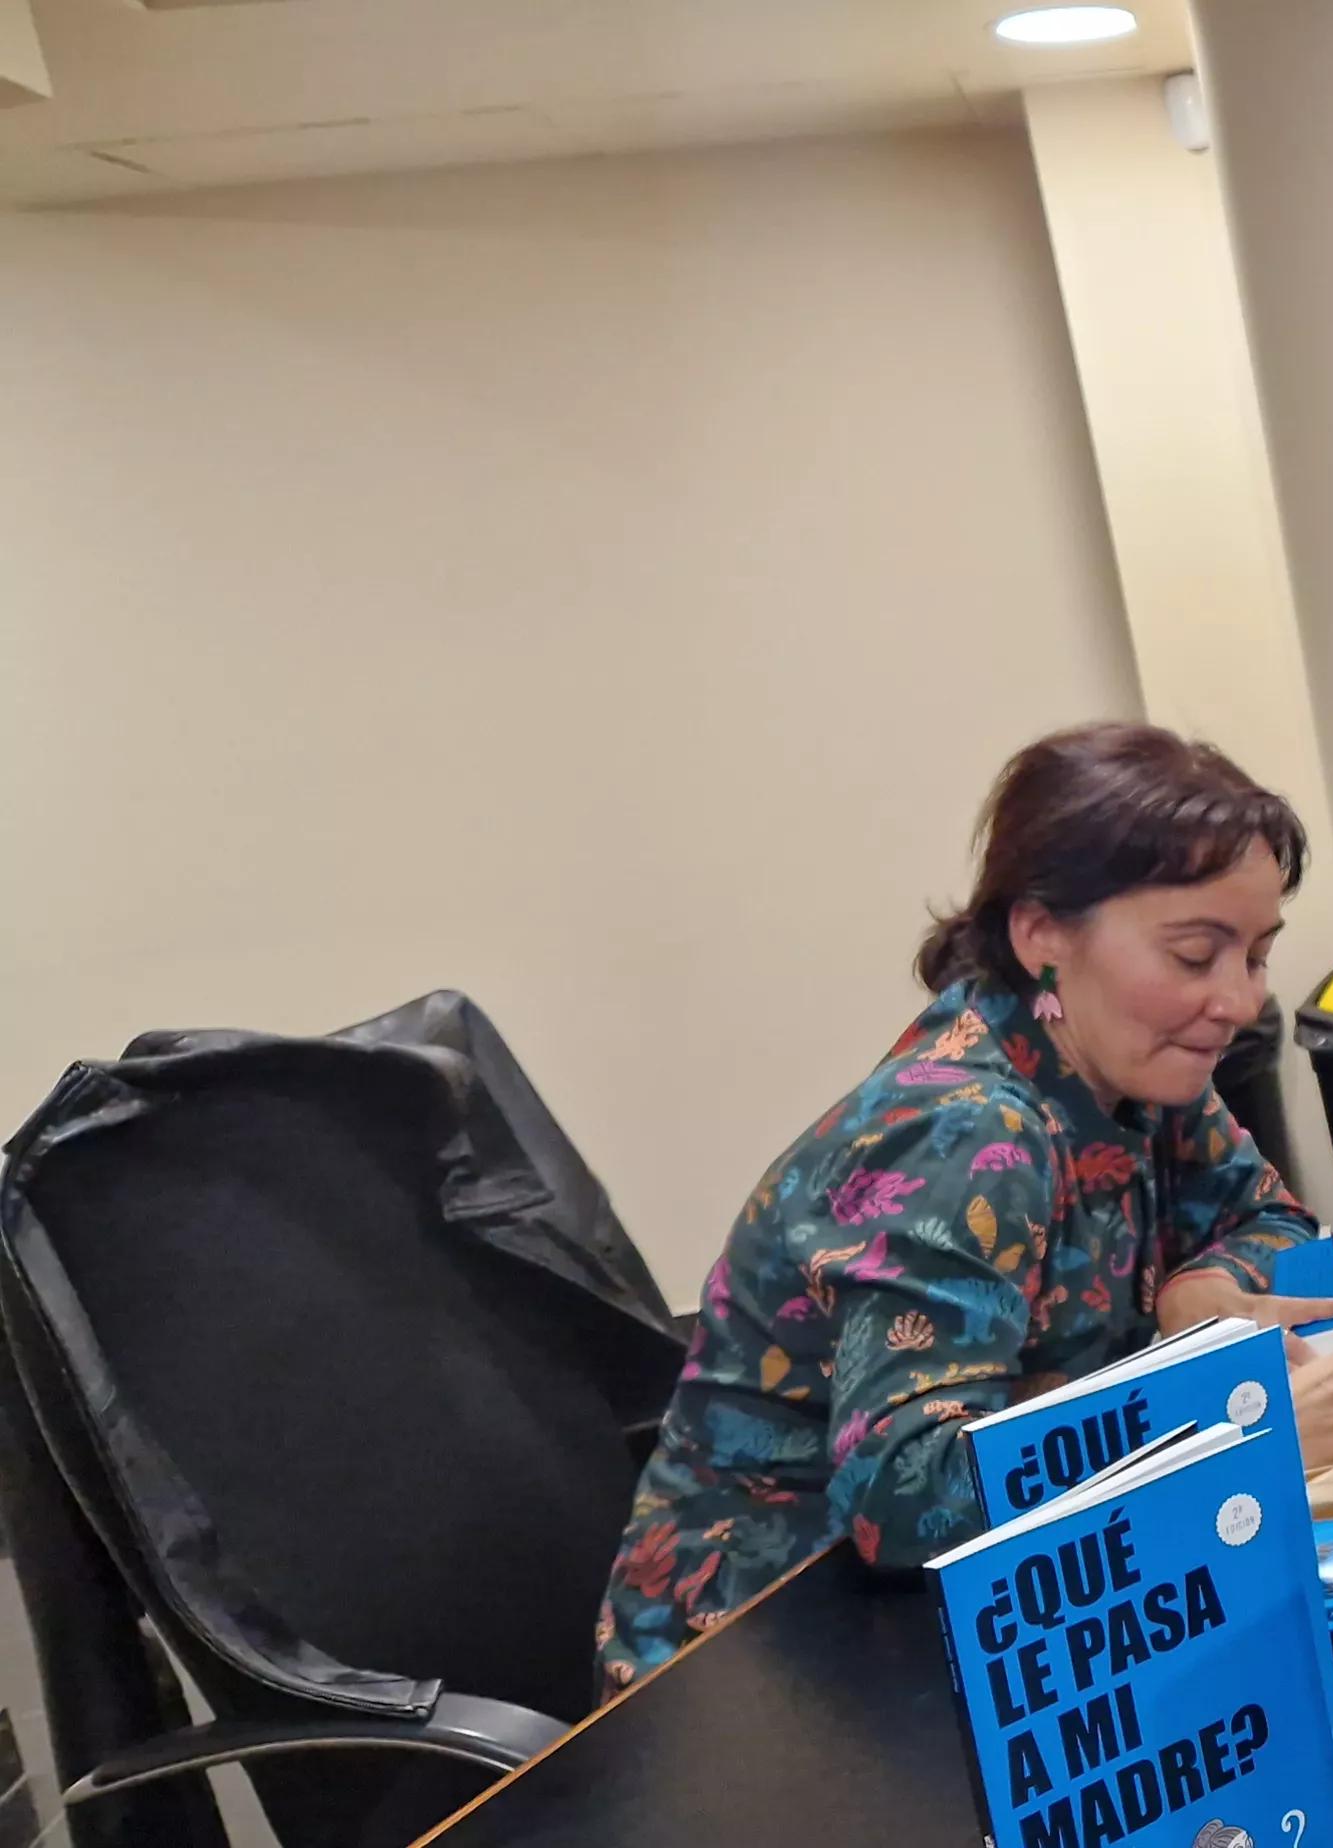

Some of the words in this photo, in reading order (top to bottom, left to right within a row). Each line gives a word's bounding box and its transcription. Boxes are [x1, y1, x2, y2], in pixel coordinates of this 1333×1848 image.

[1005, 1388, 1152, 1510] ¿QUÉ
[976, 1505, 1141, 1655] ¿QUÉ
[986, 1645, 1058, 1729] LE
[1065, 1565, 1227, 1692] PASA
[1006, 1733, 1053, 1810] A
[1058, 1683, 1144, 1780] MI
[1019, 1703, 1270, 1848] MADRE?
